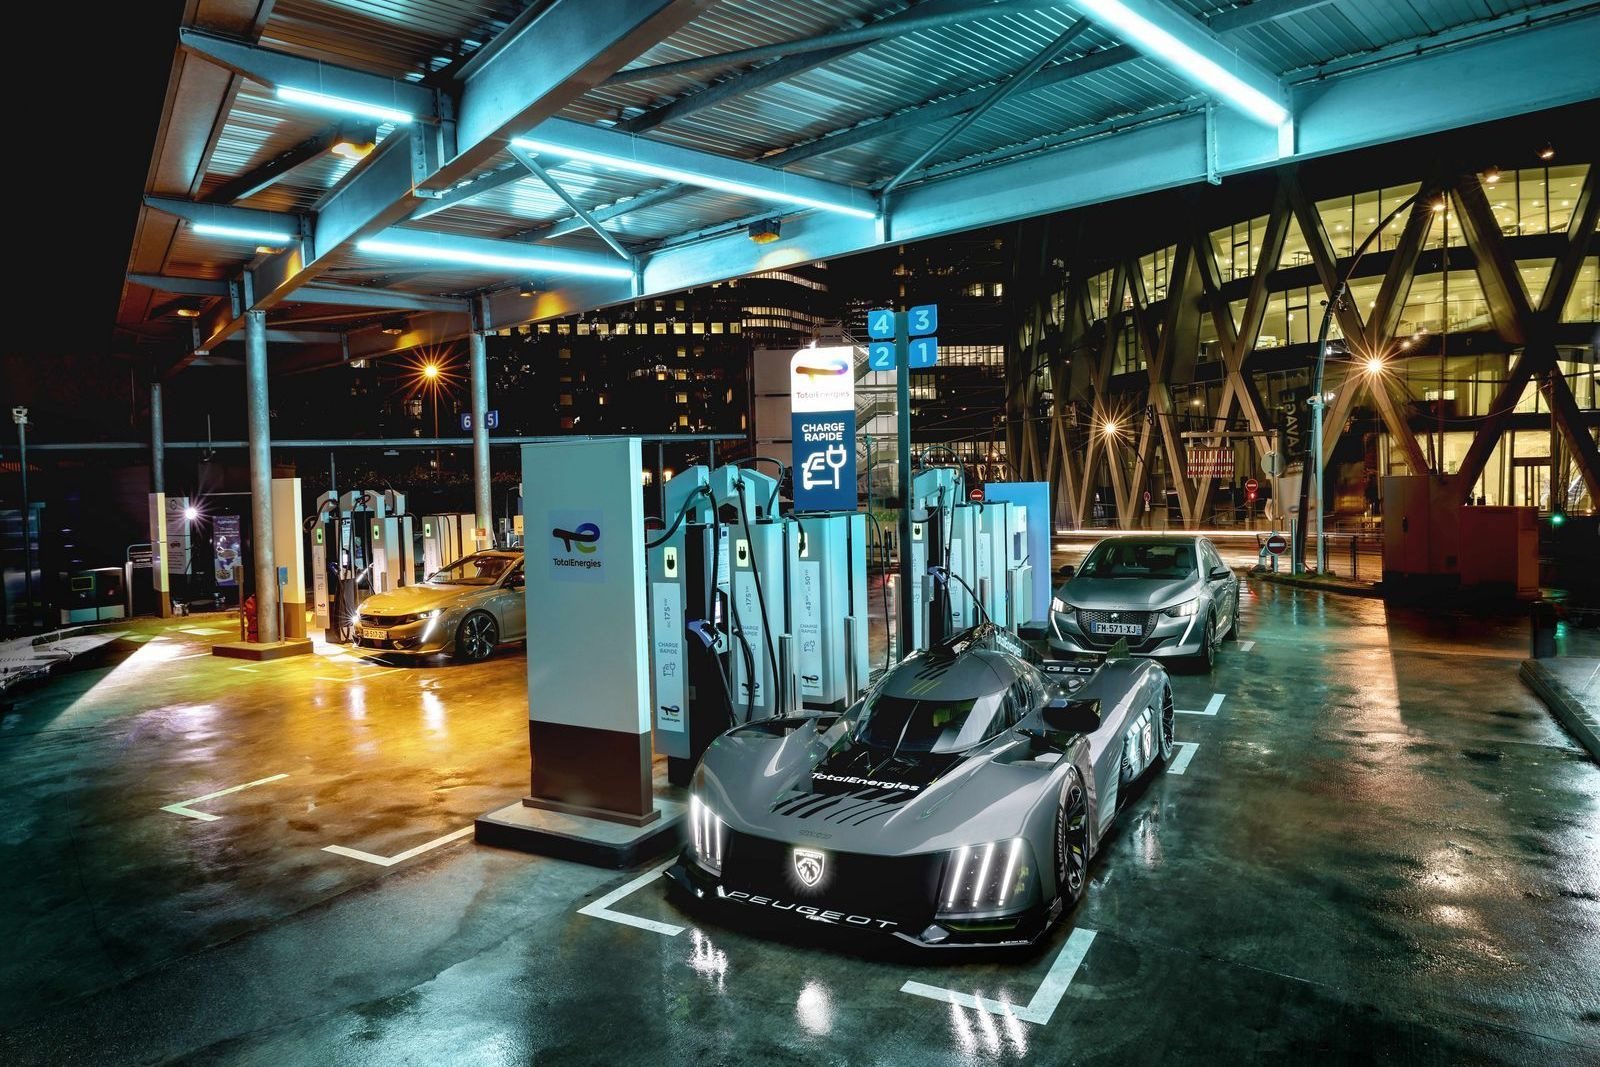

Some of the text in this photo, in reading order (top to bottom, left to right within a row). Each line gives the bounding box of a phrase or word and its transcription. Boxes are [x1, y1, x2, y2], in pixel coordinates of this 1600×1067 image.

[873, 314, 889, 334] 4
[915, 309, 930, 331] 3
[875, 346, 889, 367] 2
[918, 342, 928, 363] 1
[463, 415, 471, 428] 6
[487, 413, 494, 426] 5
[801, 422, 845, 433] CHARGE
[804, 431, 843, 442] RAPIDE
[553, 558, 602, 569] TotalEnergies
[811, 772, 920, 791] TotalEnergies
[728, 890, 898, 928] PEUGEOT
